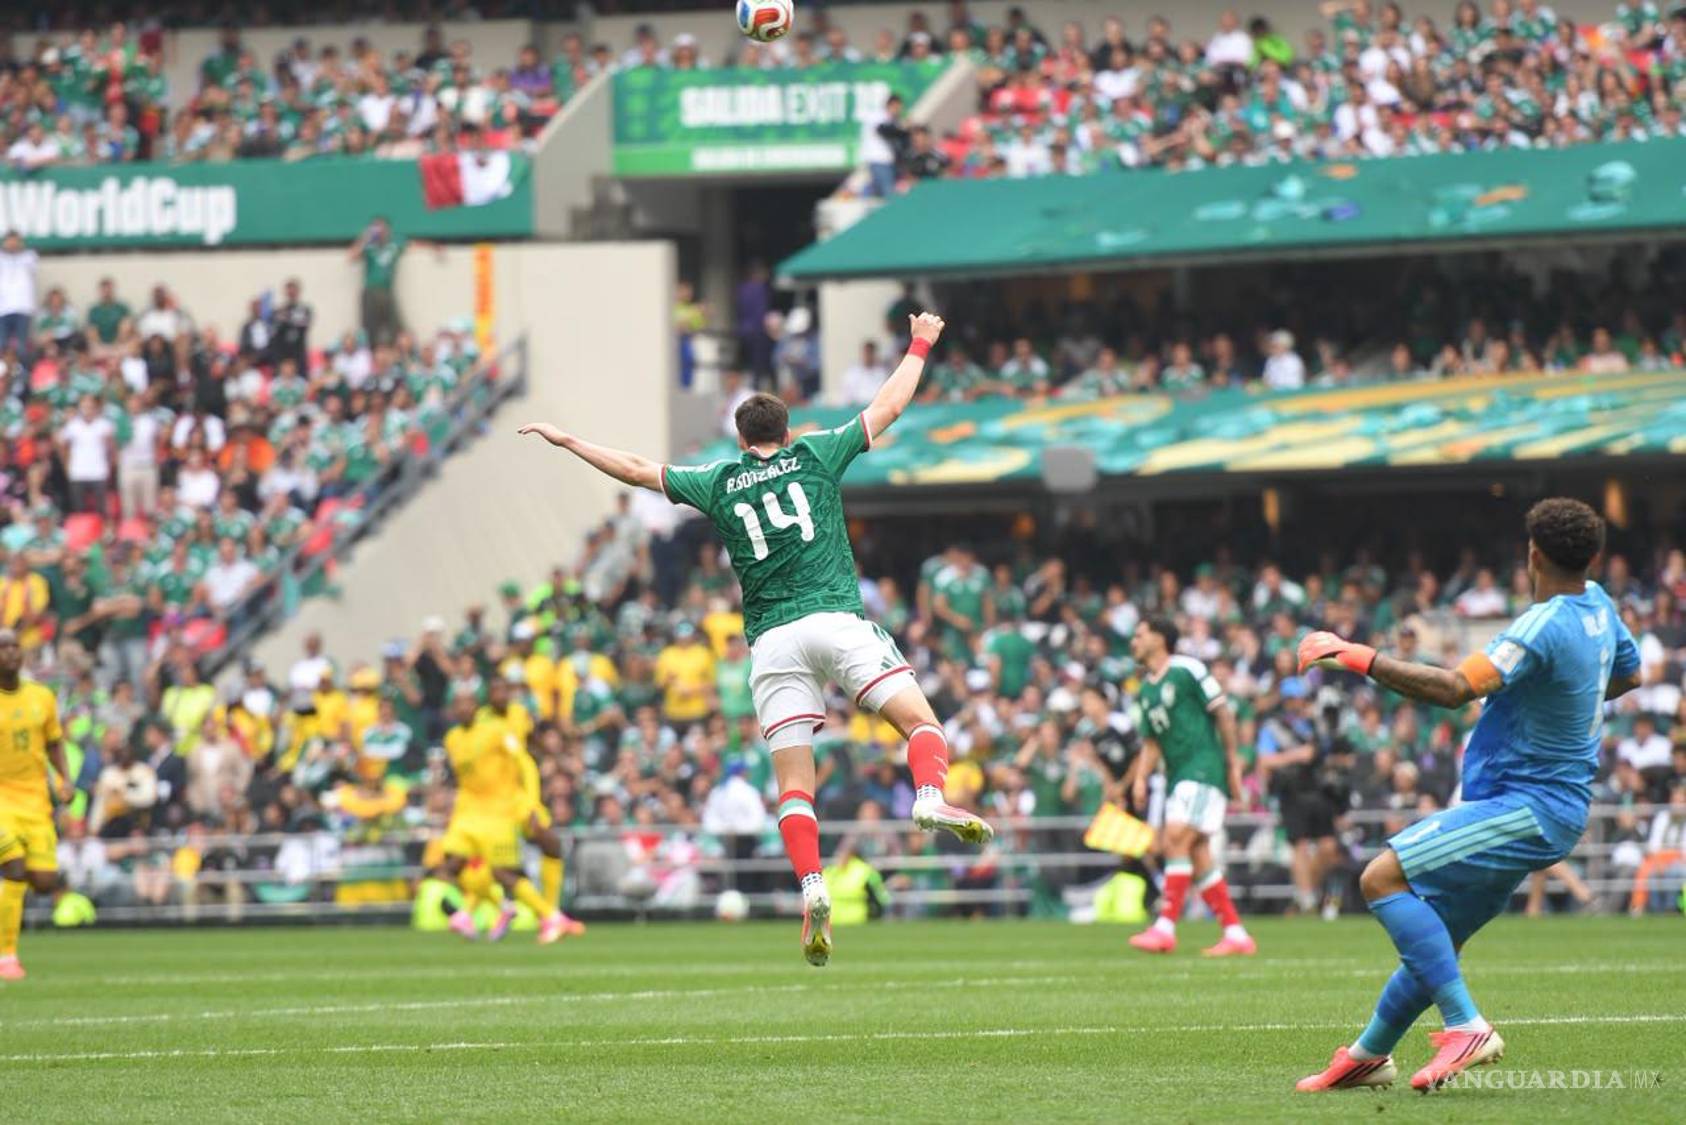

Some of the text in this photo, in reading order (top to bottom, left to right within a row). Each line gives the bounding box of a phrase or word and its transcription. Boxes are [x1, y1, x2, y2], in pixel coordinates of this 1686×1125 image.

[681, 83, 783, 128] SALIDA
[787, 81, 846, 123] EXIT
[734, 481, 815, 560] 14
